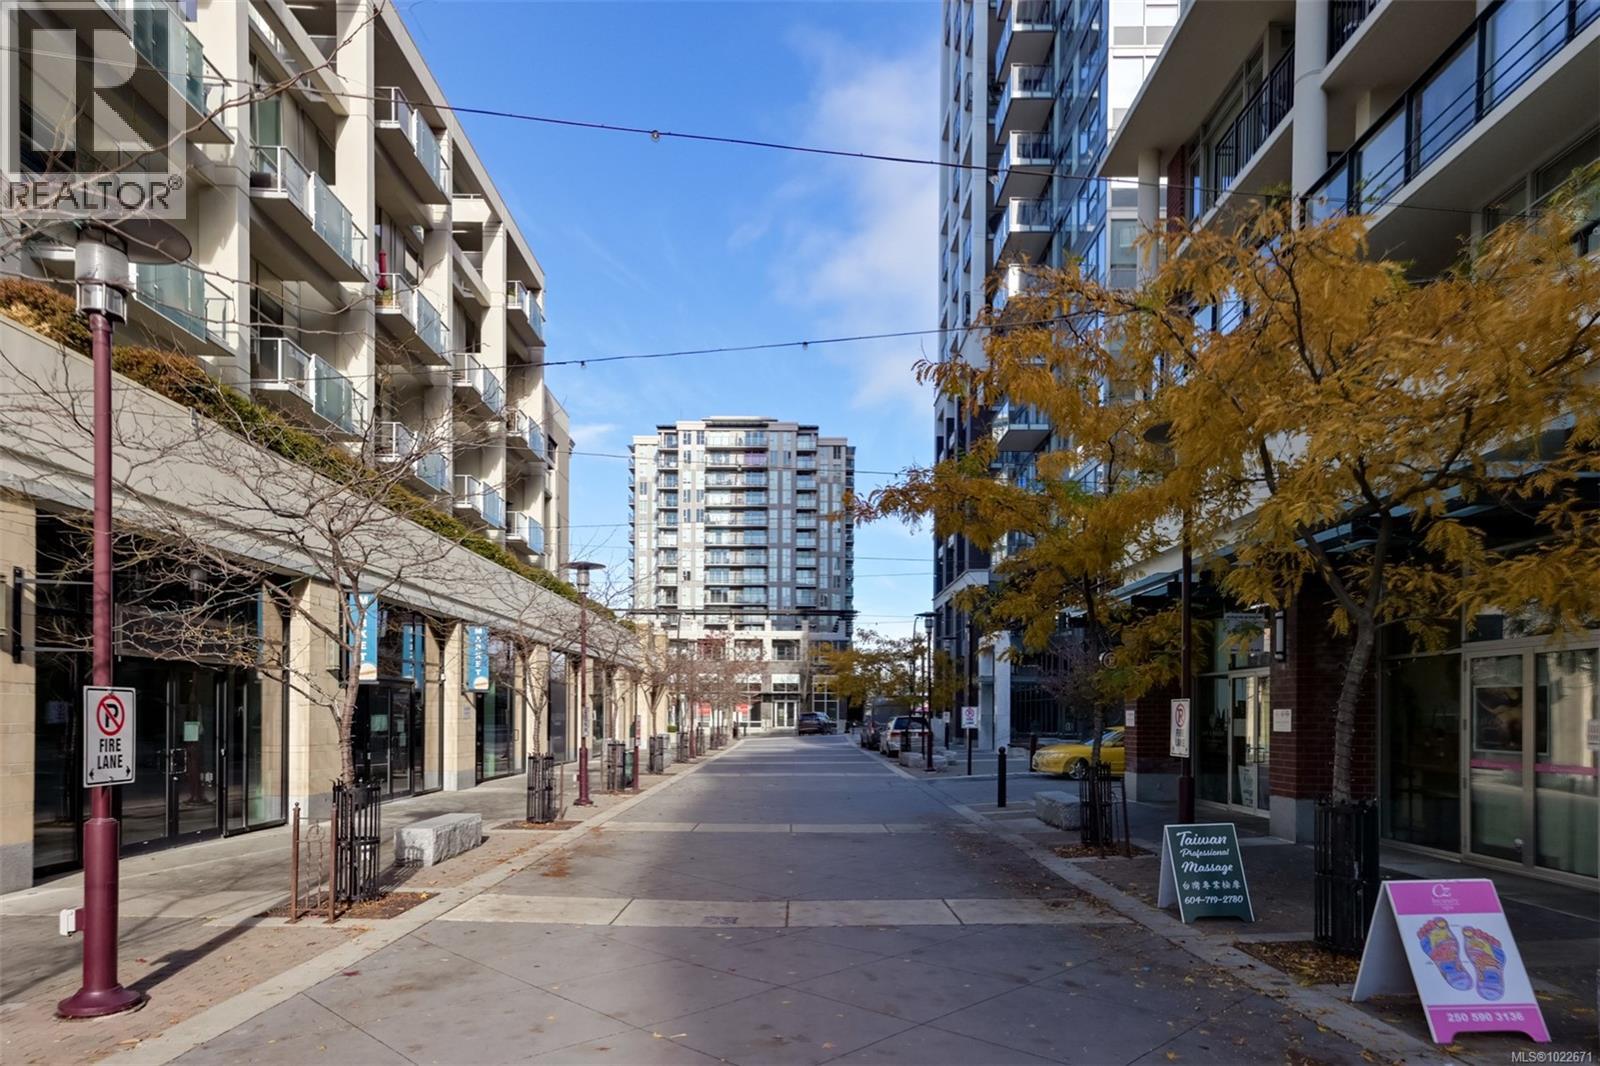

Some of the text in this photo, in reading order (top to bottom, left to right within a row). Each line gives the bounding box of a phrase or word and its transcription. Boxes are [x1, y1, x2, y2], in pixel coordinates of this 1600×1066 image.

[359, 595, 369, 662] MKET
[99, 738, 121, 753] FIRE
[97, 754, 123, 770] LANE
[1176, 831, 1227, 846] Taiwan
[1180, 848, 1229, 858] Professional
[1181, 861, 1233, 875] Massage
[1184, 895, 1243, 904] 604-719-2780
